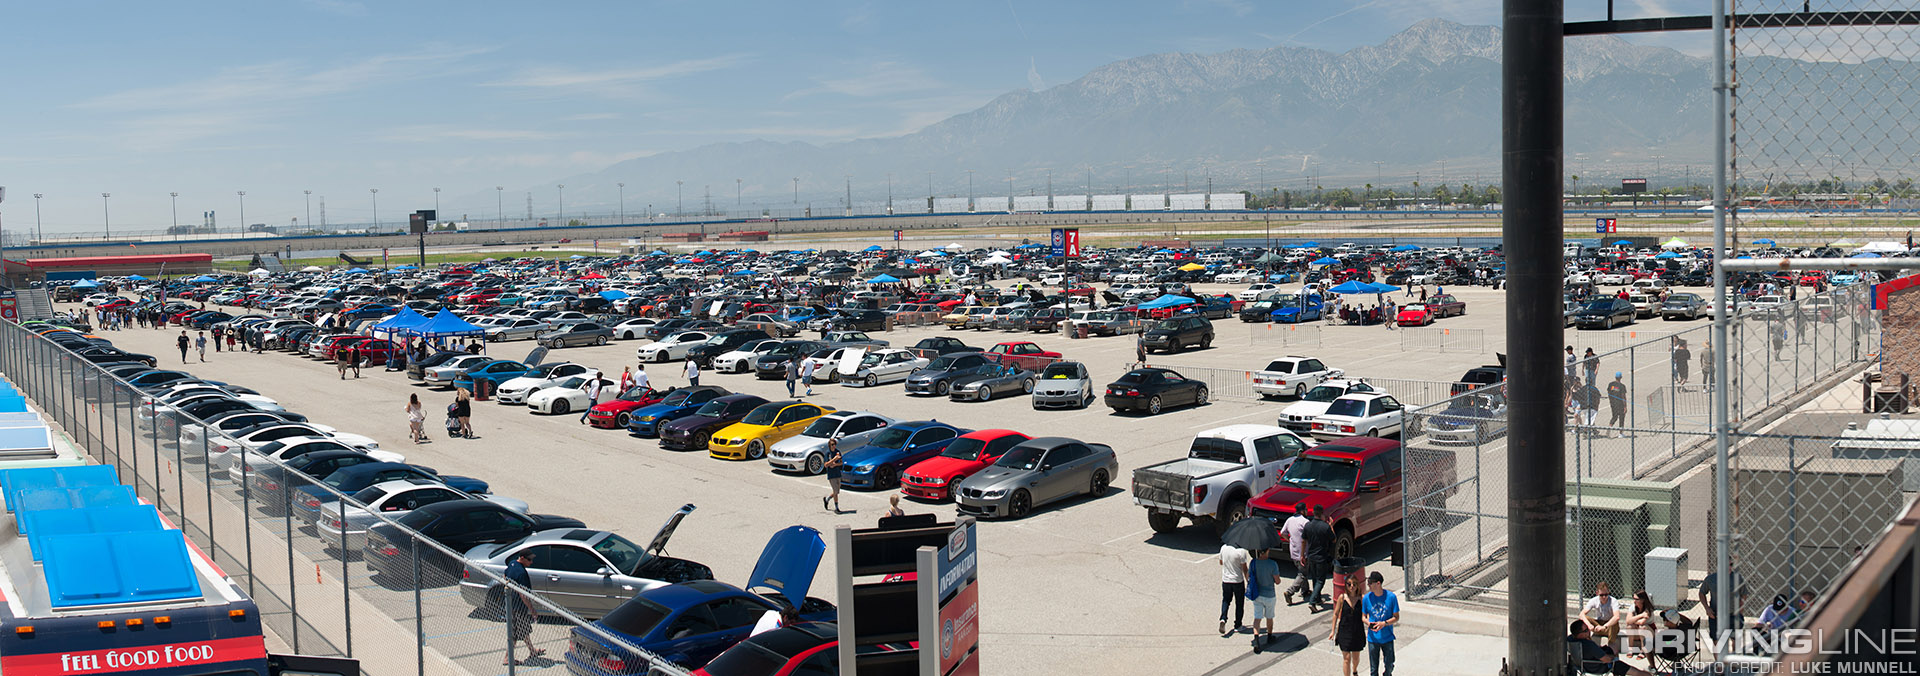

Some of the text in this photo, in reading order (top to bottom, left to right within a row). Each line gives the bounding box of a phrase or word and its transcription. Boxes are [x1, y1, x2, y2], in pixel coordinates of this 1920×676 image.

[1069, 232, 1076, 243] 7
[1069, 244, 1077, 255] A
[940, 552, 975, 594] INFORMATION
[954, 602, 976, 631] Insurance
[61, 644, 214, 671] FEEL GOOD FOOD
